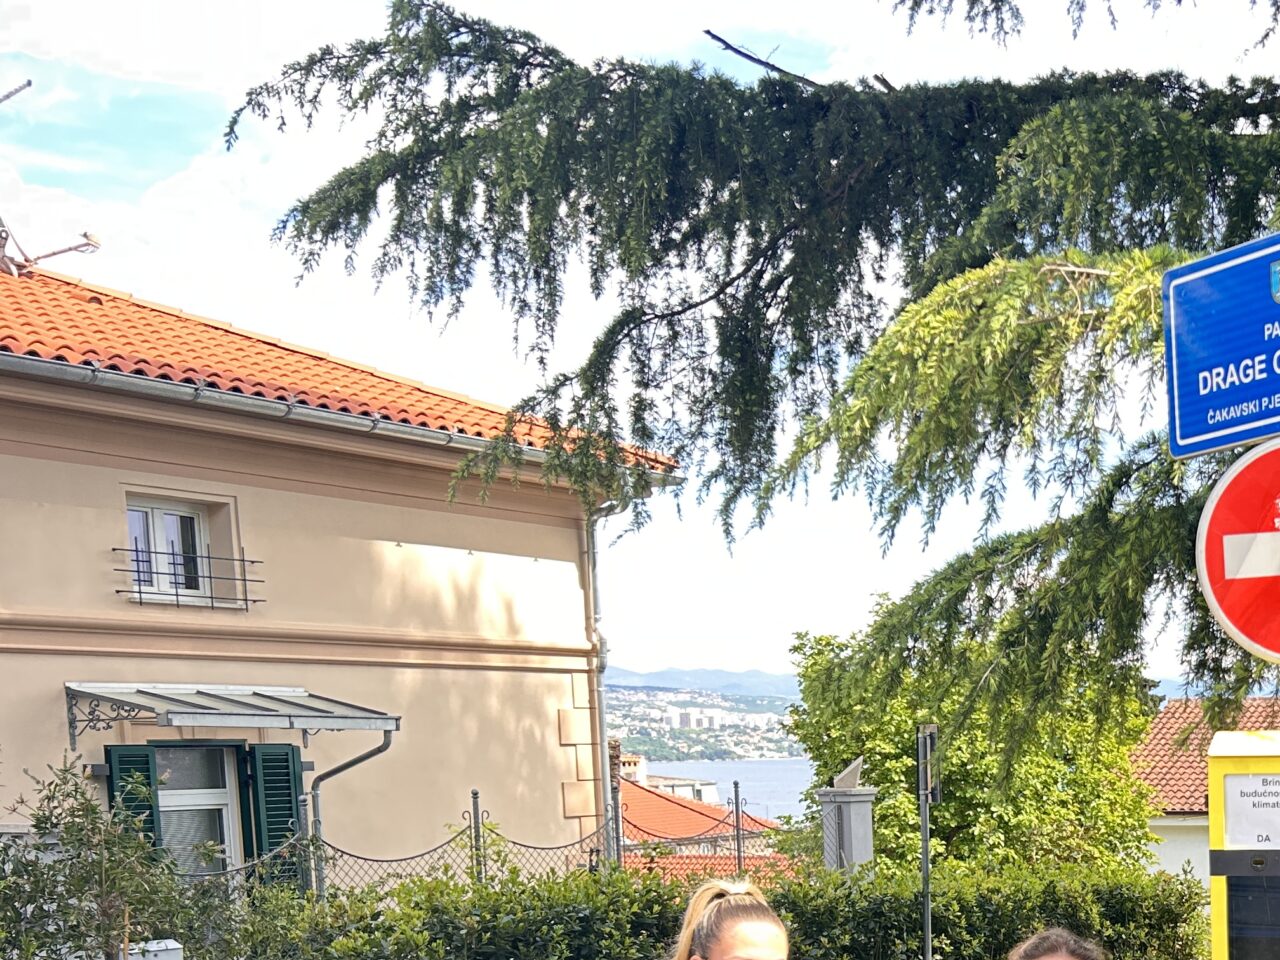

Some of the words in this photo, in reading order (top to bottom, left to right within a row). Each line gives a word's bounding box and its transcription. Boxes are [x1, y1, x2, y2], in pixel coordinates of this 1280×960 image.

[1199, 355, 1267, 395] DRAGE
[1208, 401, 1258, 424] ČAKAVSKI
[1256, 834, 1271, 843] DA
